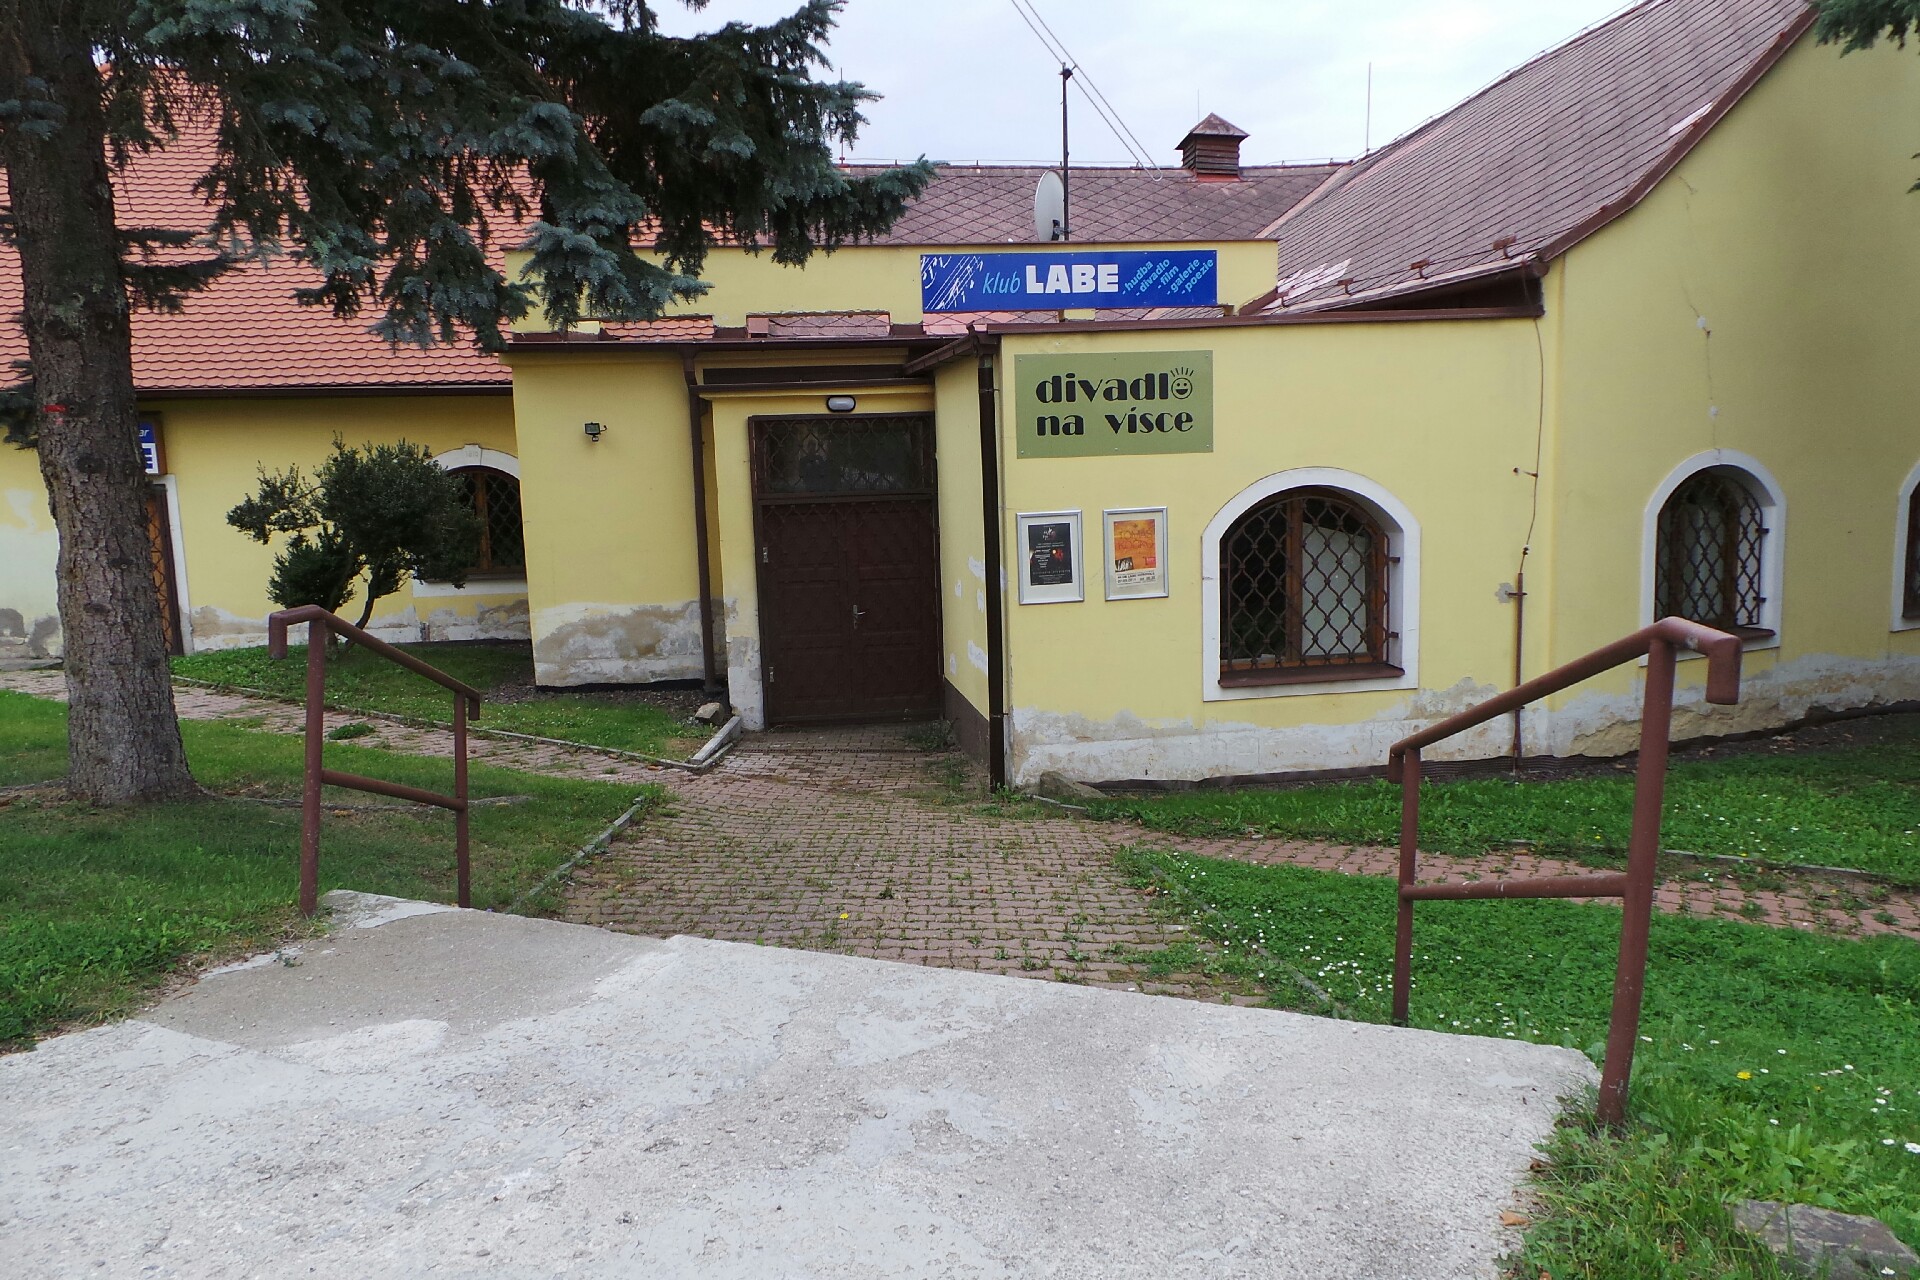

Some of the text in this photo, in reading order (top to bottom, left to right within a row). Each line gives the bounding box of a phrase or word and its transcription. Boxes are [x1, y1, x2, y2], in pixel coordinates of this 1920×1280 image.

[982, 264, 1119, 294] klub LABE
[1035, 370, 1193, 403] divadlo
[1036, 414, 1084, 436] na
